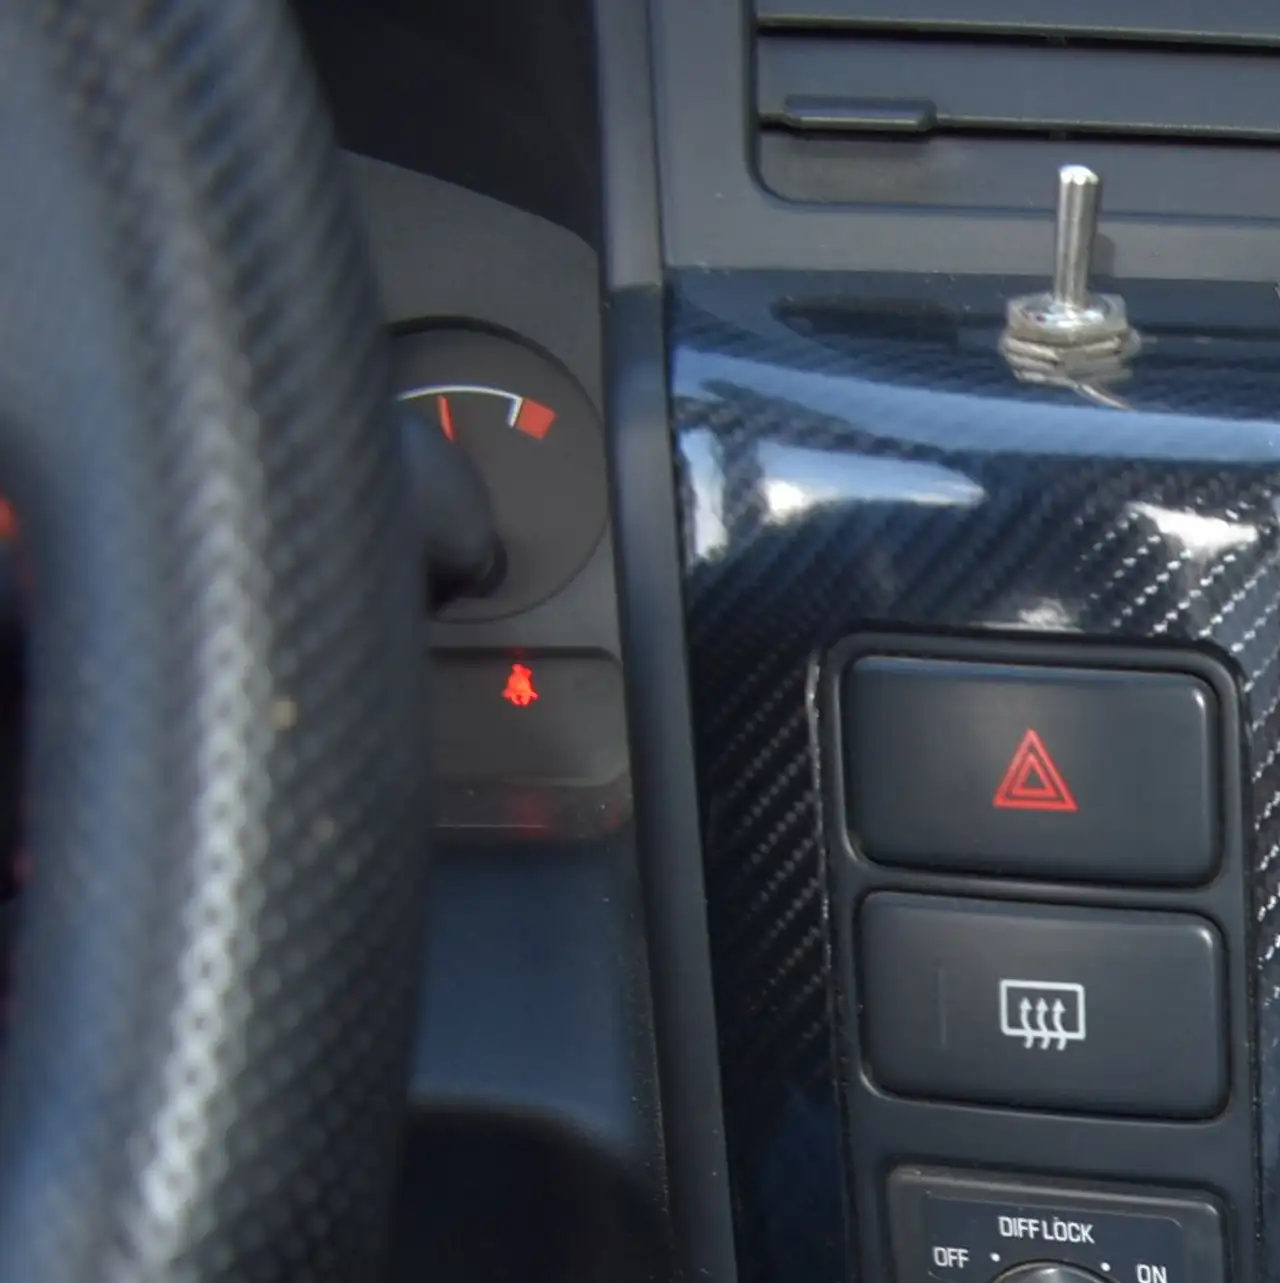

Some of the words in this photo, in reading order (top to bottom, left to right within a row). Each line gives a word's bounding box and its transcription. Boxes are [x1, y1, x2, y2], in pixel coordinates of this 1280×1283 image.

[998, 1215, 1040, 1239] DIFF
[1041, 1219, 1095, 1244] LOCK
[933, 1246, 969, 1269] OFF
